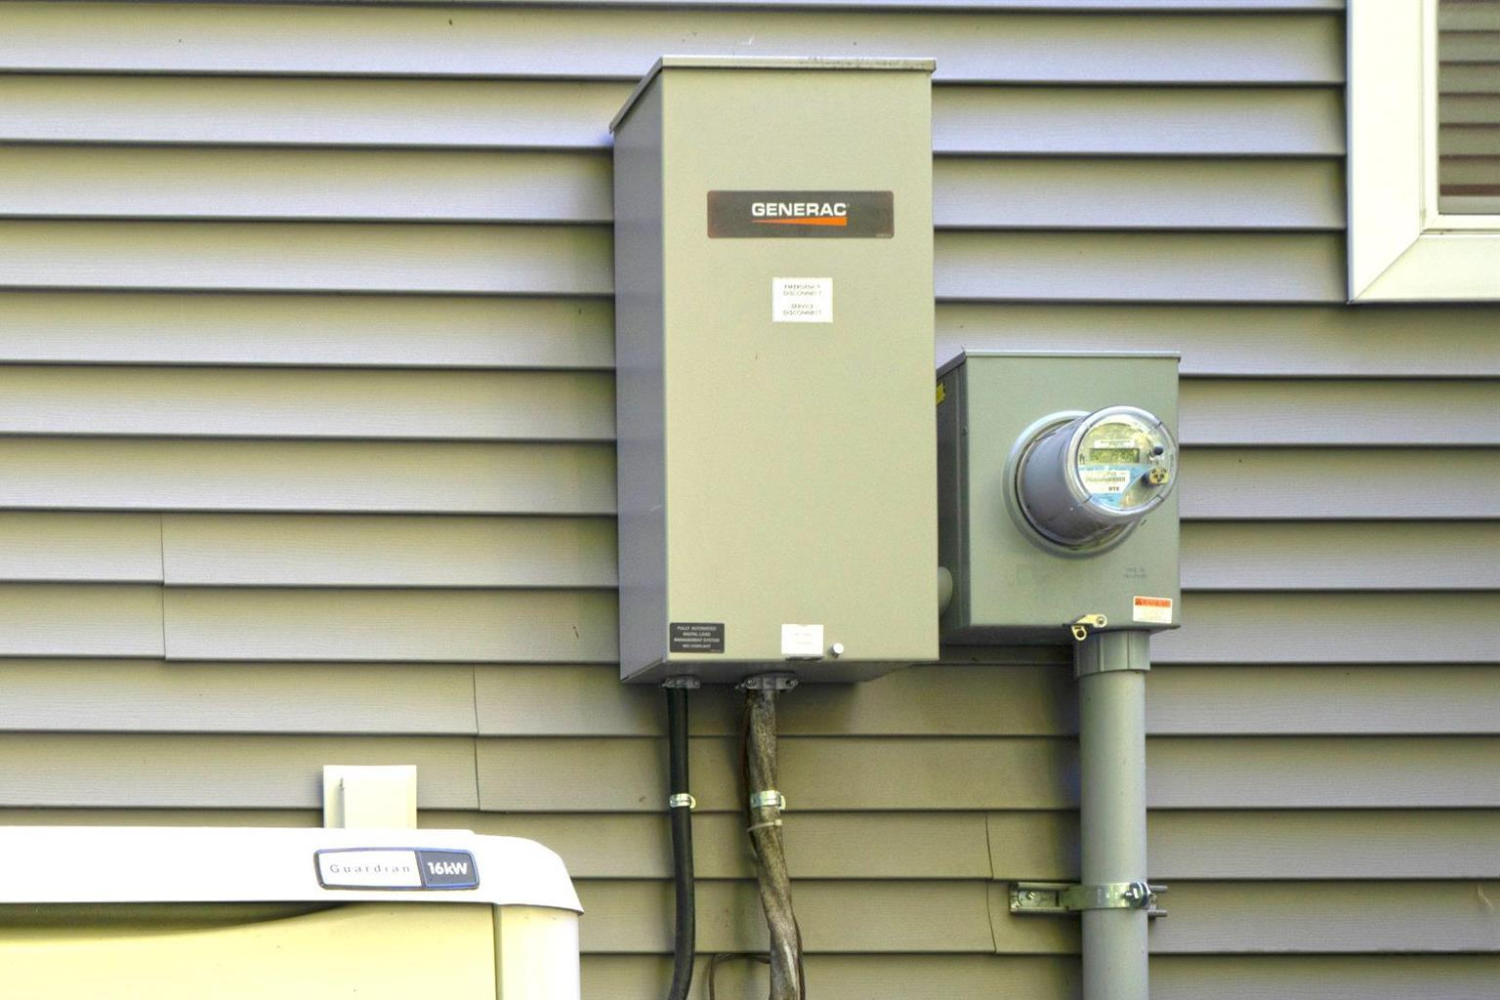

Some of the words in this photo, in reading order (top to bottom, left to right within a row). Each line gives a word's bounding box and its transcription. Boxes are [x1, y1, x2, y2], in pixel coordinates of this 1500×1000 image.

[751, 202, 847, 217] GENERAC
[329, 863, 411, 874] Guardian
[427, 861, 469, 875] 16kW
